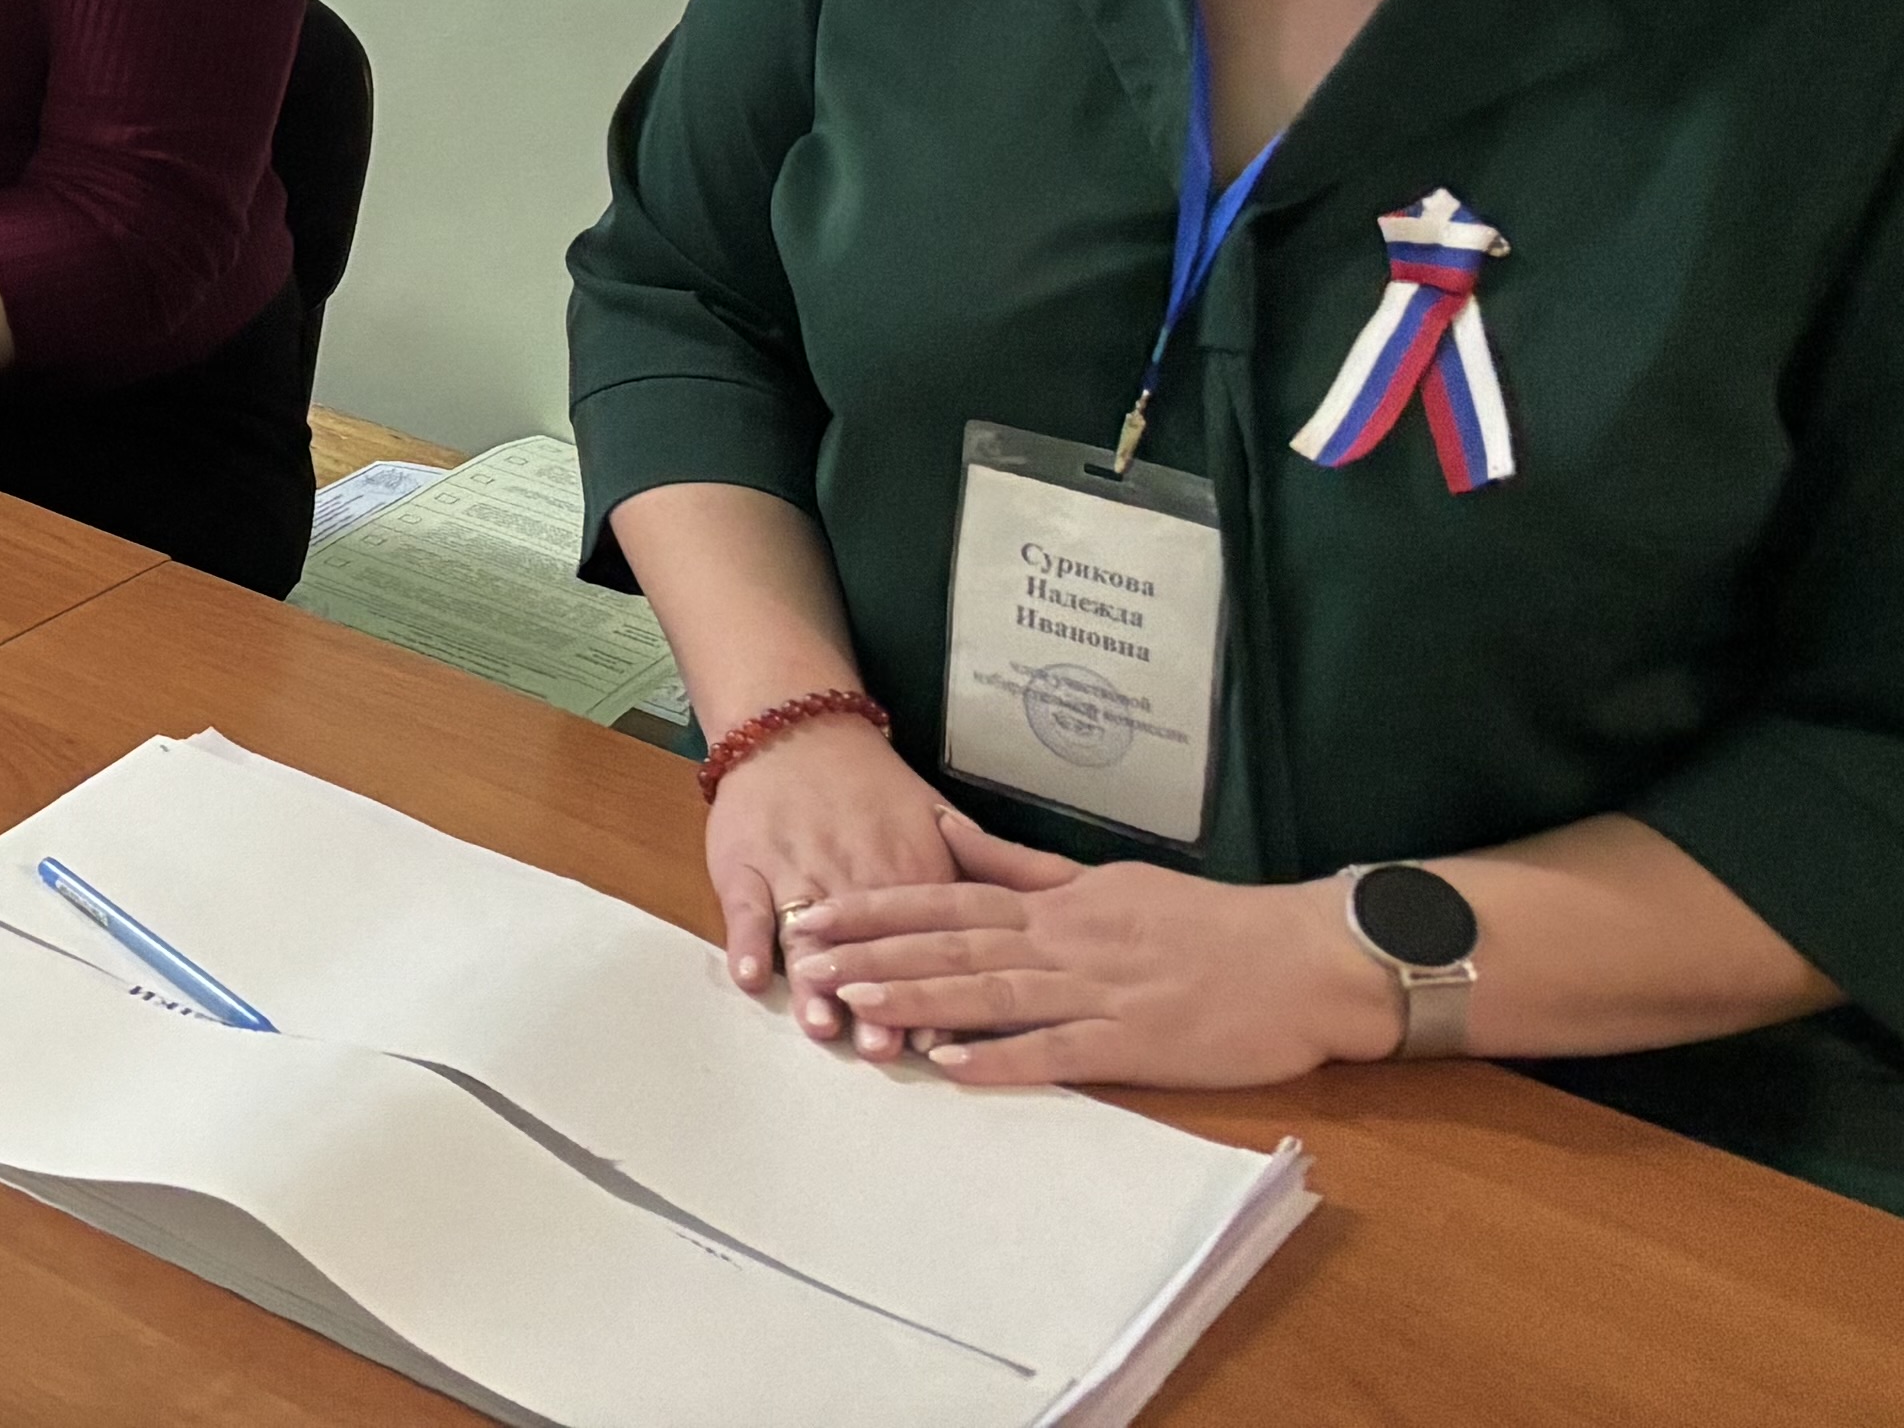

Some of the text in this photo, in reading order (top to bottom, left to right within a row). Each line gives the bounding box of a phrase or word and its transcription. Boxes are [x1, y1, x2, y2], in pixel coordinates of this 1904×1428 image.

[1021, 542, 1155, 597] Сурикова
[1026, 576, 1144, 628] Надежда
[1016, 605, 1150, 662] Ивановна
